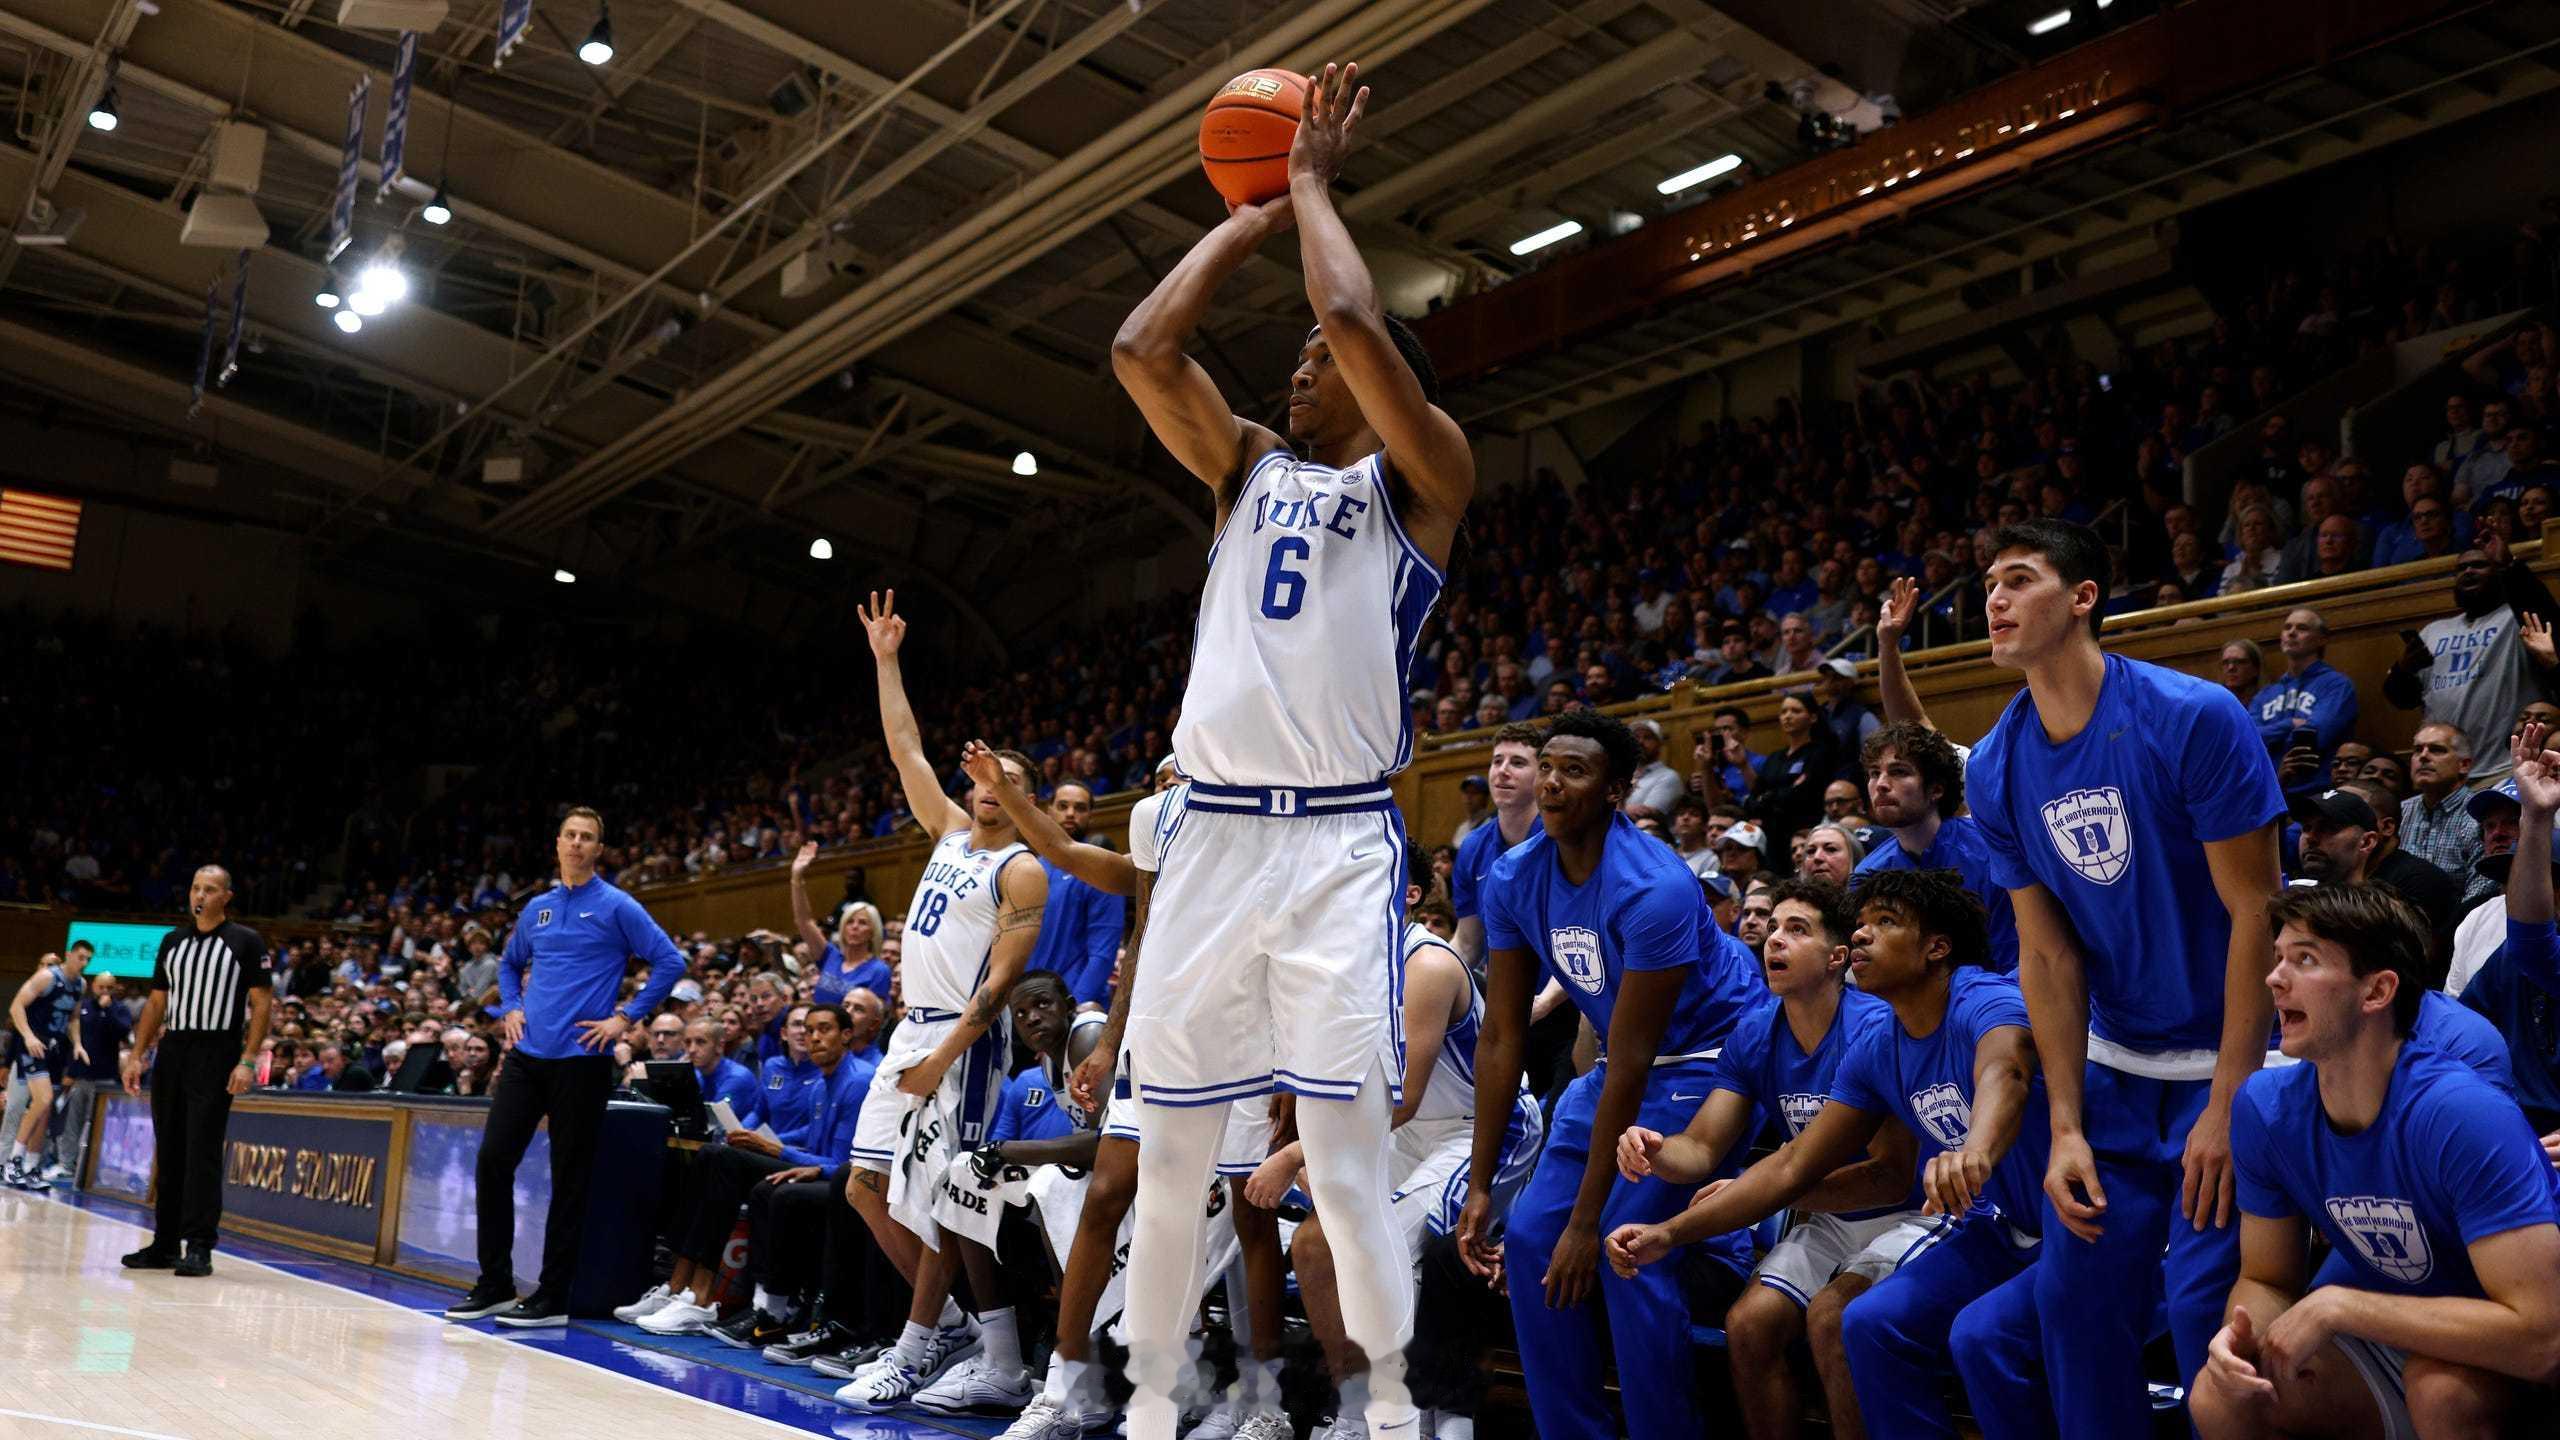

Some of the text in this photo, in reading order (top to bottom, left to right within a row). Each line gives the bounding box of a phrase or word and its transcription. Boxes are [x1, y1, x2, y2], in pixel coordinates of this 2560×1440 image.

[1253, 491, 1368, 540] DUKE
[1261, 536, 1310, 620] 6
[2064, 806, 2119, 824] BROTHERHOOD
[924, 862, 978, 900] DUKE
[911, 888, 948, 938] 18
[291, 1149, 376, 1209] STADIUM
